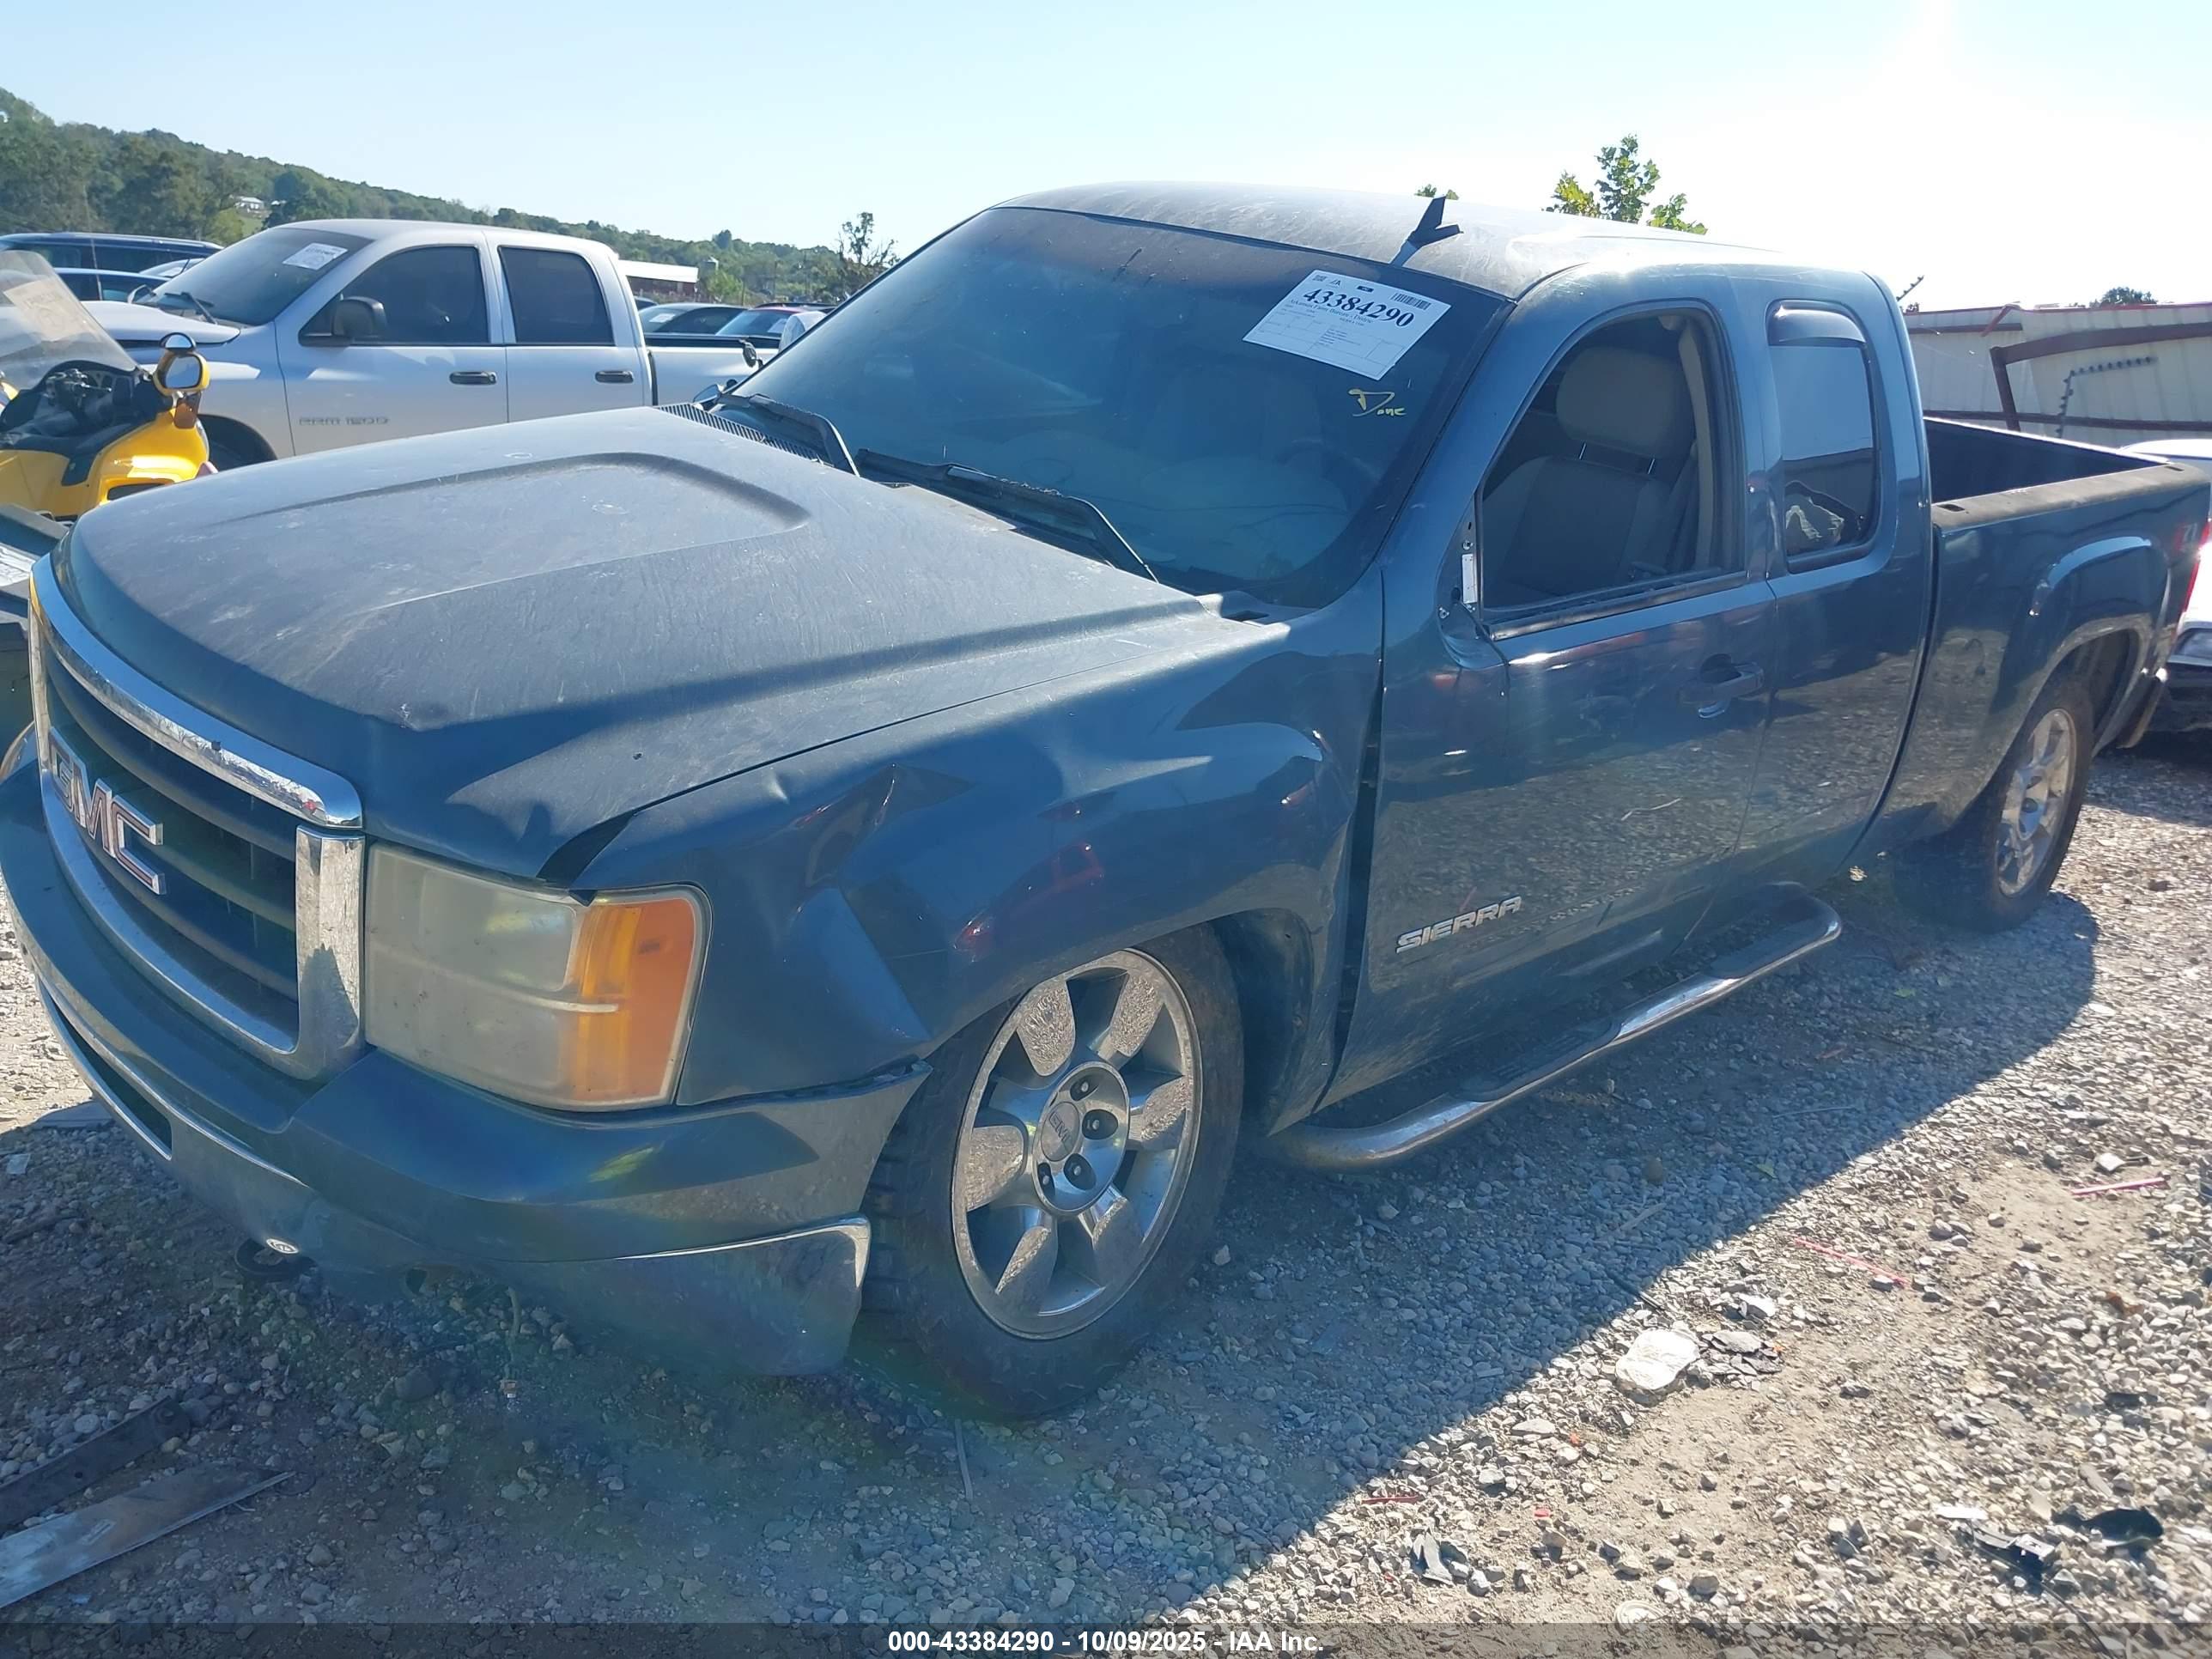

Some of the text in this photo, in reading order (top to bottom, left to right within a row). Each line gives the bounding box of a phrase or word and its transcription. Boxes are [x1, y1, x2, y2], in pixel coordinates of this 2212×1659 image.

[1304, 289, 1414, 326] 43384290
[1348, 389, 1407, 417] Done
[49, 727, 165, 896] GMC
[1395, 896, 1522, 954] SIERRA
